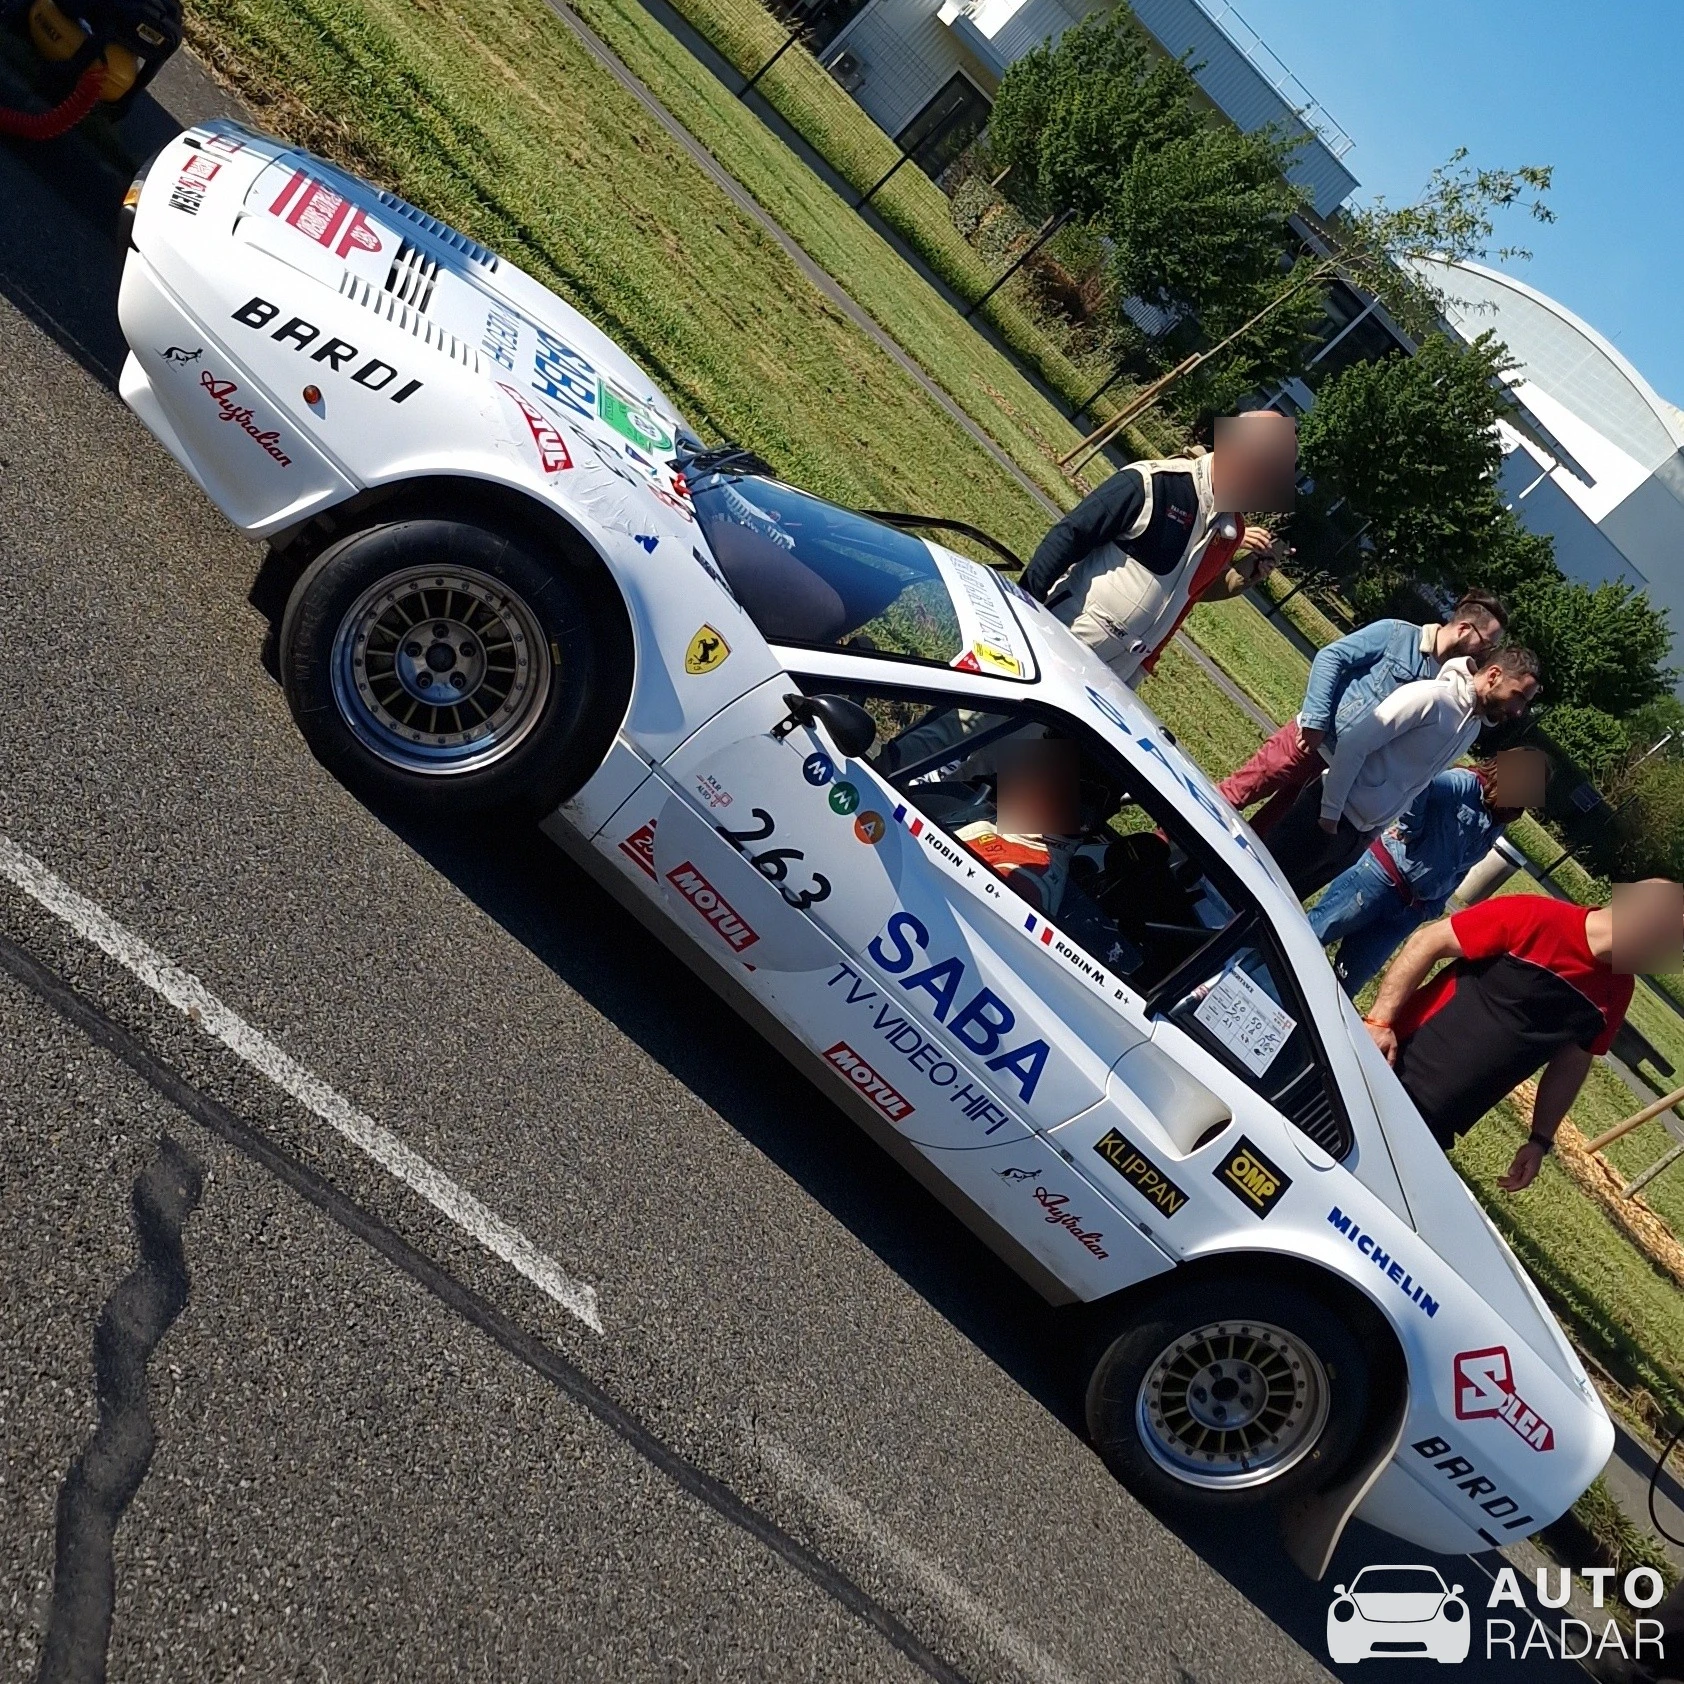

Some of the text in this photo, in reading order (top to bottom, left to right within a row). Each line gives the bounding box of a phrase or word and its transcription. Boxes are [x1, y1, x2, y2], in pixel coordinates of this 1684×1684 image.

[231, 297, 424, 403] BARDI
[531, 328, 596, 421] SABA
[200, 370, 292, 468] Australian
[715, 807, 832, 910] 263
[924, 832, 963, 868] ROBIN
[673, 869, 752, 947] MOTUL
[1055, 941, 1093, 975] ROBIN
[867, 911, 1051, 1105] SABA
[828, 1047, 909, 1119] MOTUL
[1097, 1132, 1185, 1214] KLIPPAN
[1231, 1155, 1276, 1198] OMP
[1032, 1186, 1109, 1261] Australian
[1327, 1206, 1440, 1319] MICHELIN
[1411, 1436, 1534, 1531] BARDI
